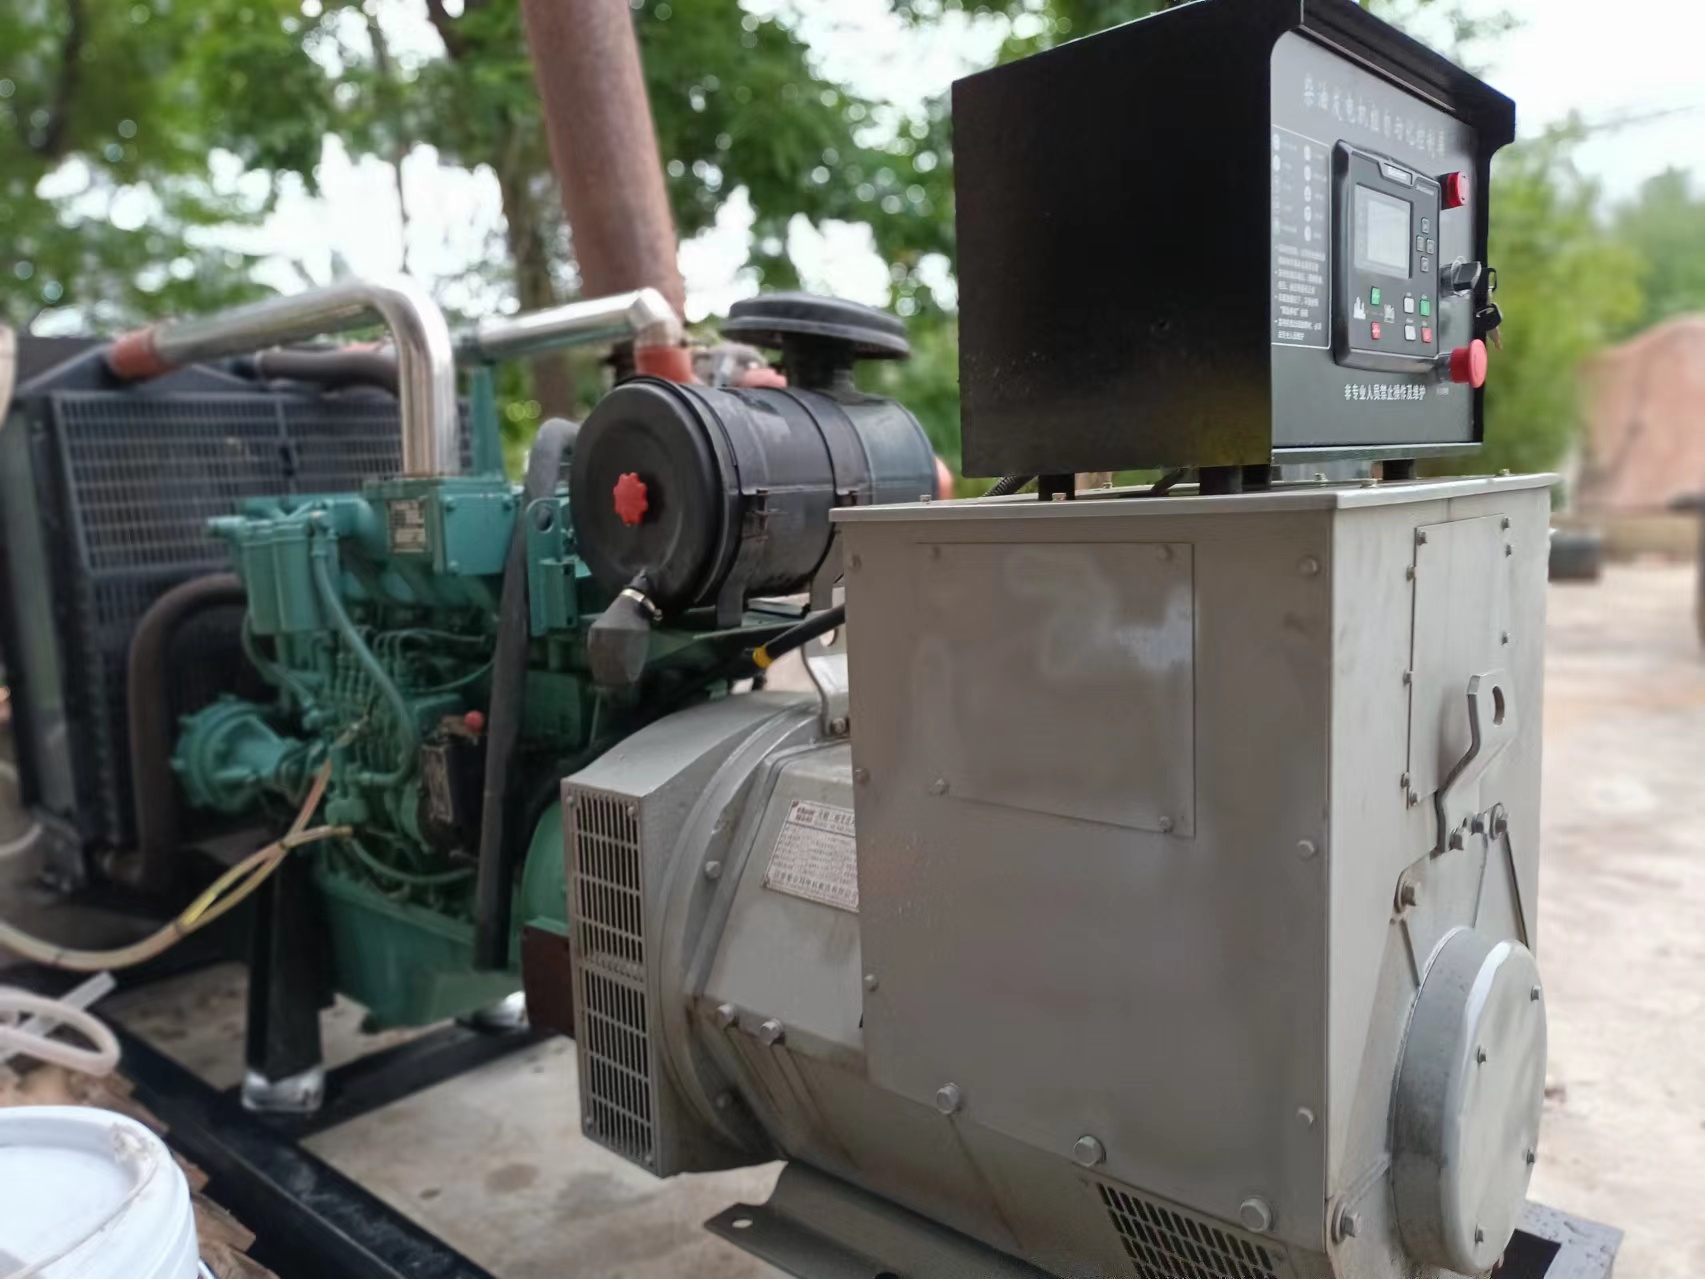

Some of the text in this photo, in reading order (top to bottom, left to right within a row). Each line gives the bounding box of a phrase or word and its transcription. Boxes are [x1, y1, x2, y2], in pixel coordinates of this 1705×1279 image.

[1344, 384, 1426, 400] 非专业人员禁止操作及维护
